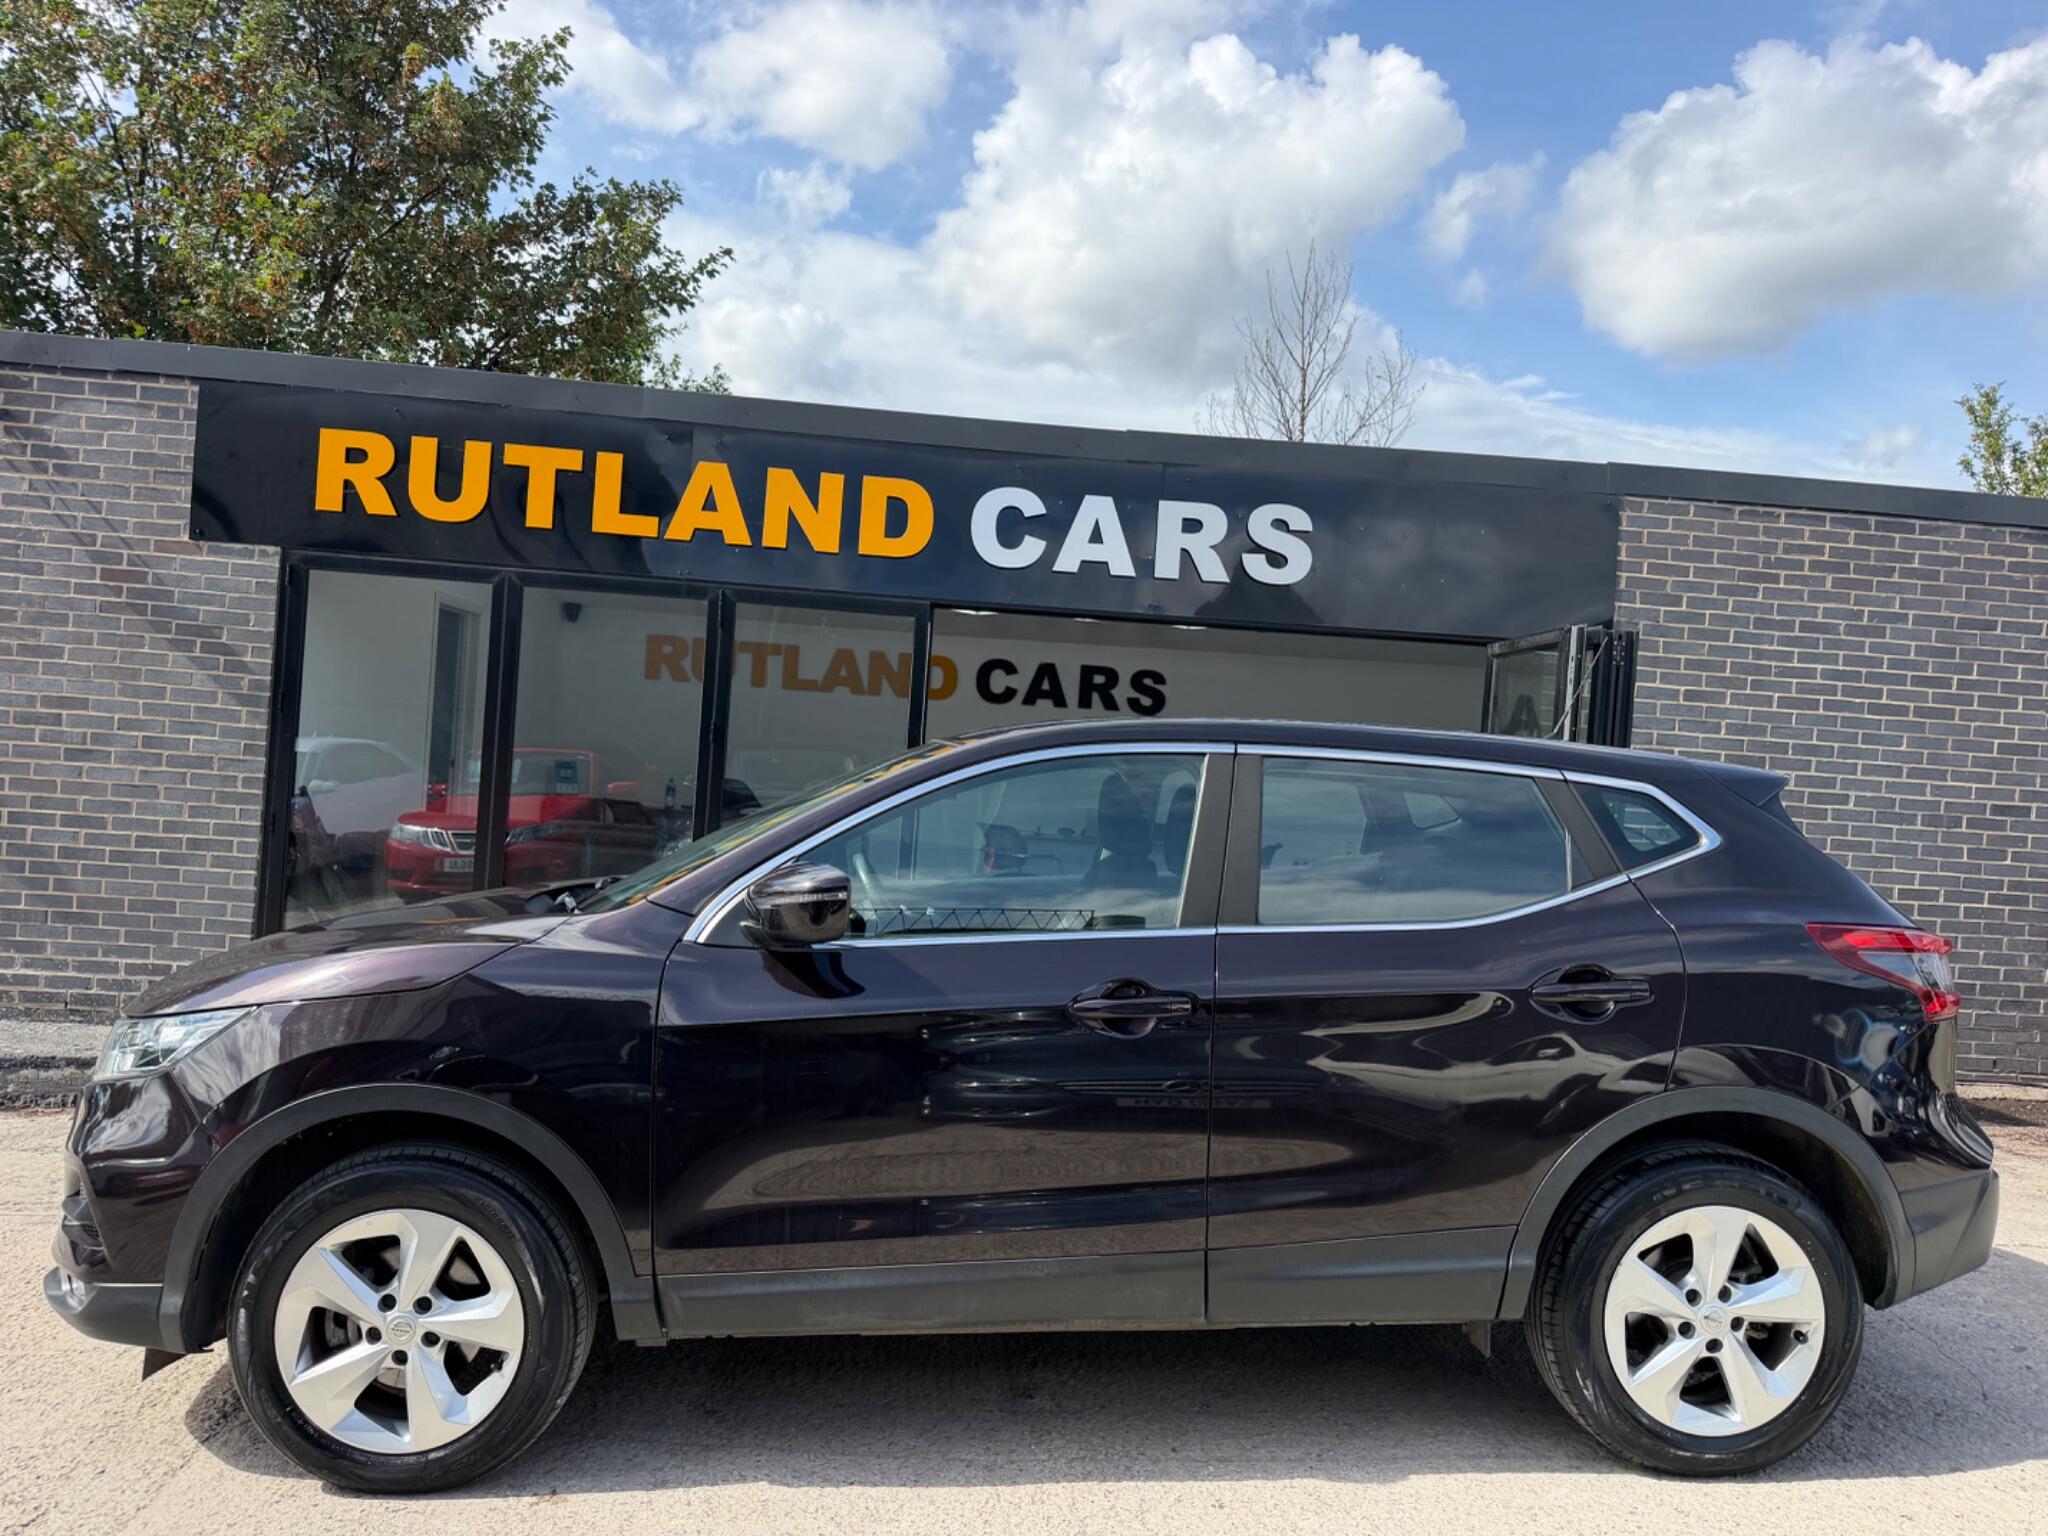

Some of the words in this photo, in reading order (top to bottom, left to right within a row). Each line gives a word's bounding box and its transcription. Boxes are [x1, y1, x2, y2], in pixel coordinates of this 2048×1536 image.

[315, 428, 935, 558] RUTLAND
[971, 486, 1313, 586] CARS
[976, 658, 1167, 717] CARS
